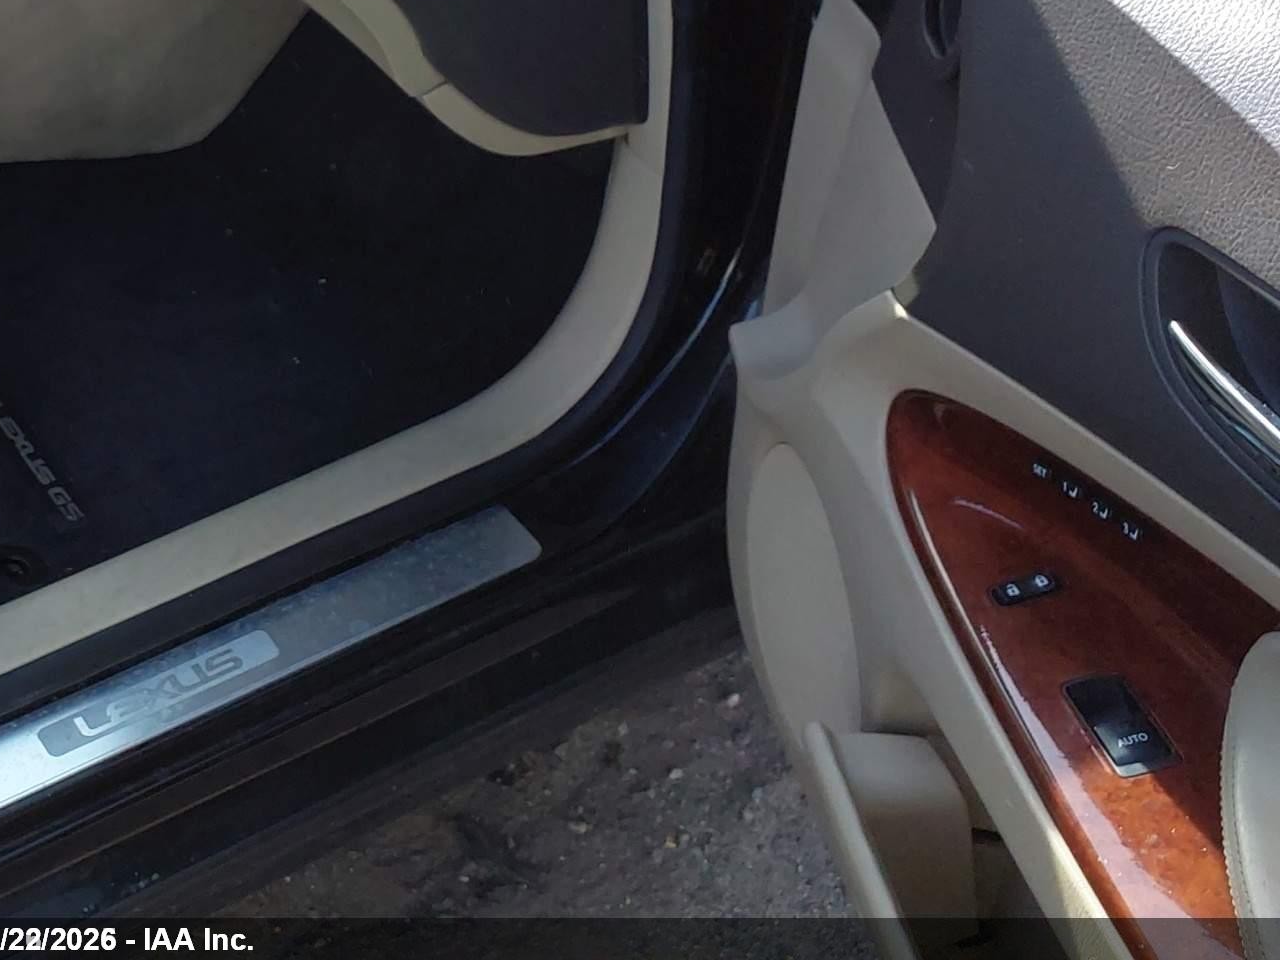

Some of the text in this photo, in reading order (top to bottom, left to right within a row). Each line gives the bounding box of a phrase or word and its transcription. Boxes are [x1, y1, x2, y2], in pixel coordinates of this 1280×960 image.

[47, 485, 86, 521] GS
[72, 648, 244, 737] LEXUS
[1117, 732, 1149, 749] AUTO
